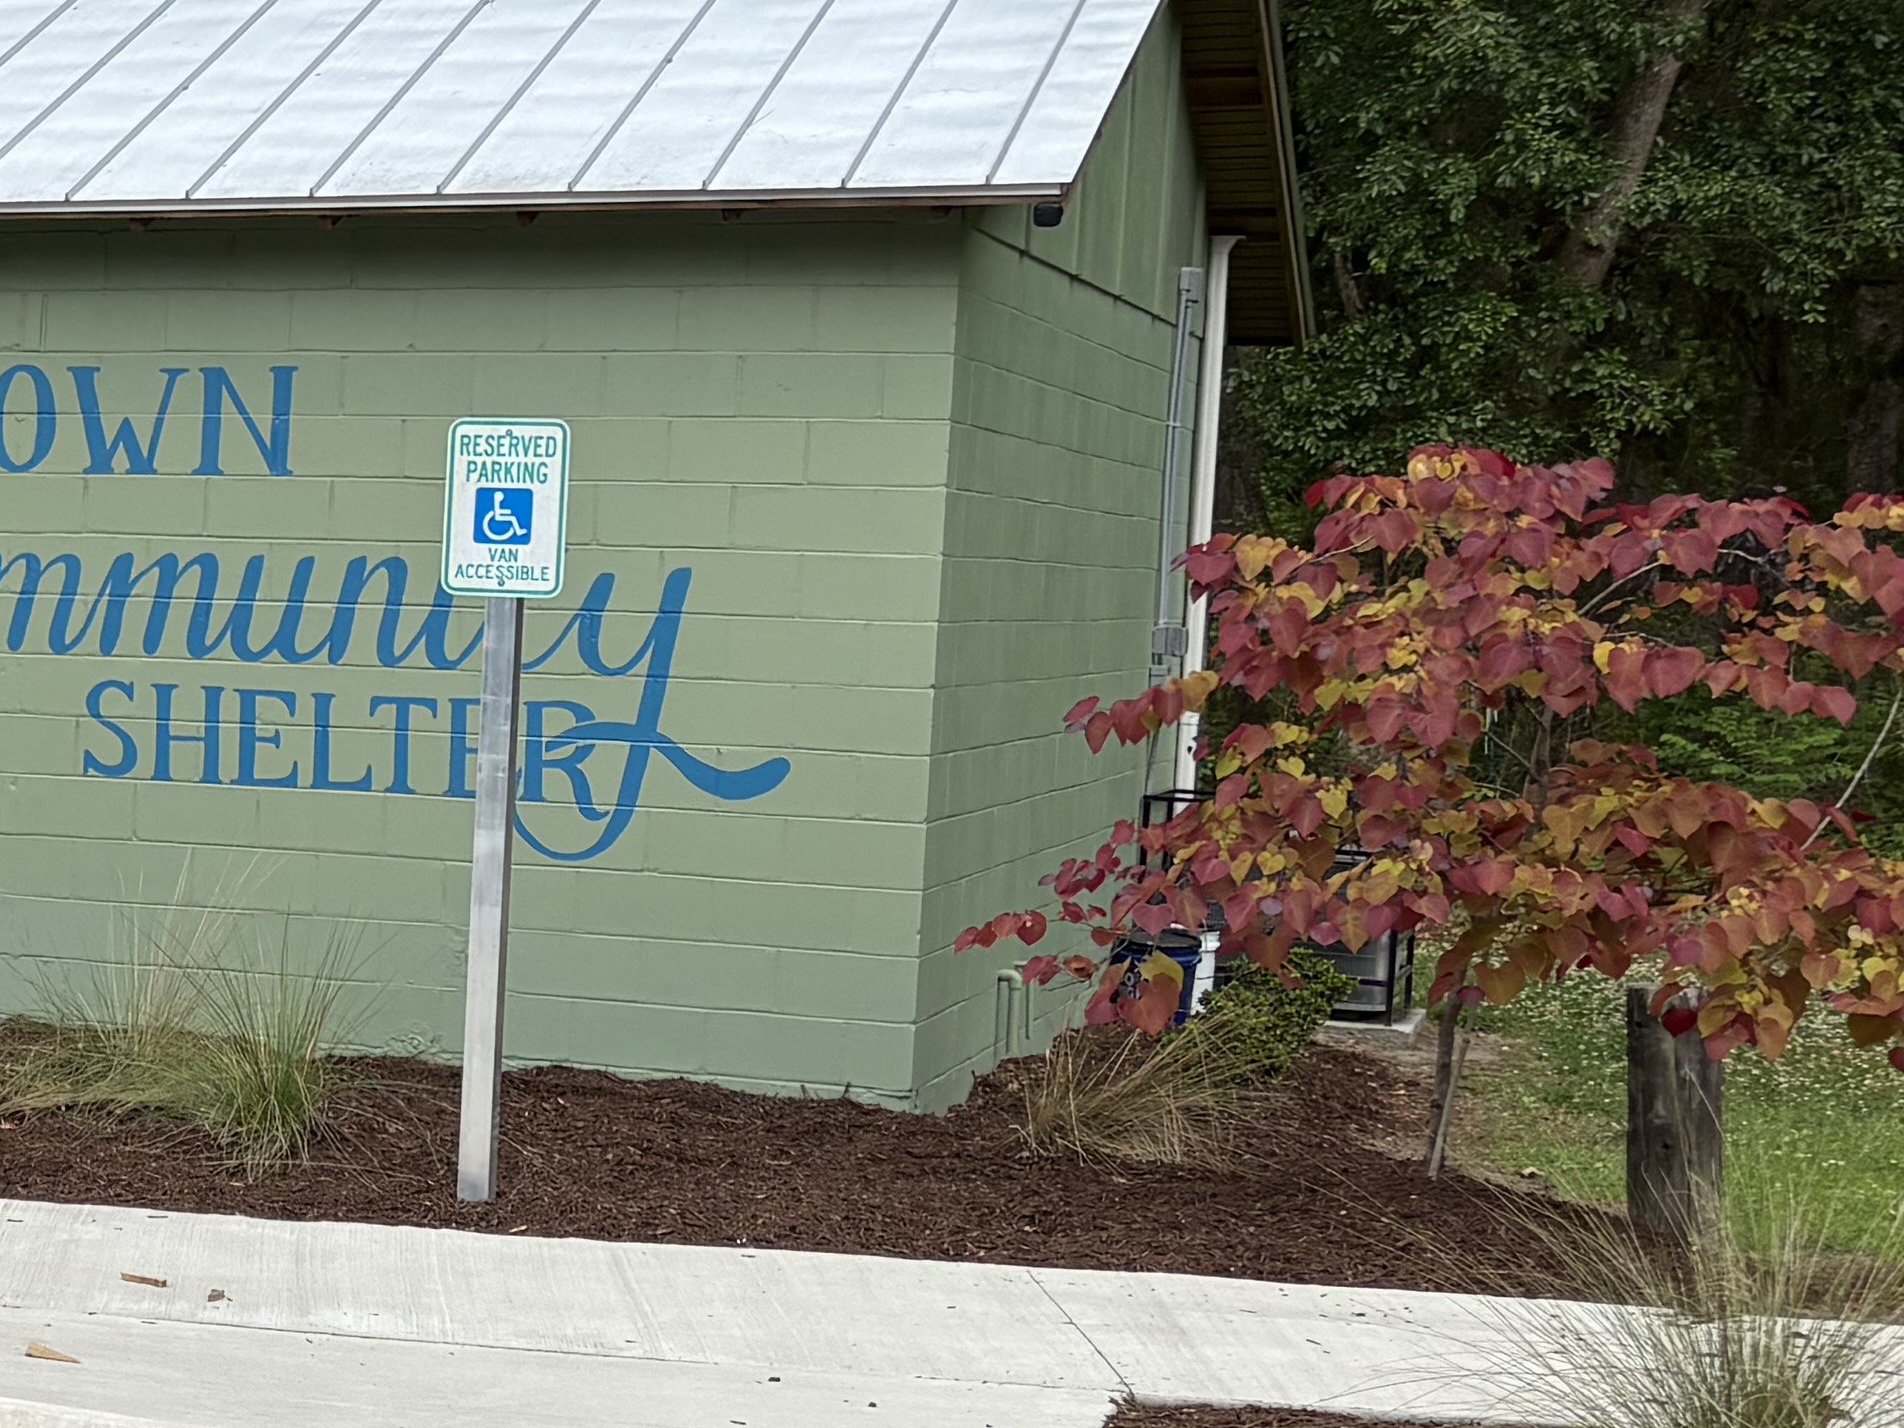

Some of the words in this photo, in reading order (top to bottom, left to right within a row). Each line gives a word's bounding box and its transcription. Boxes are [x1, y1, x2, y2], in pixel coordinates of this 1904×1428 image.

[460, 434, 557, 458] RESERVED
[466, 460, 548, 484] PARKING
[488, 548, 519, 563] VAN
[455, 564, 550, 581] ACCESSIBLE
